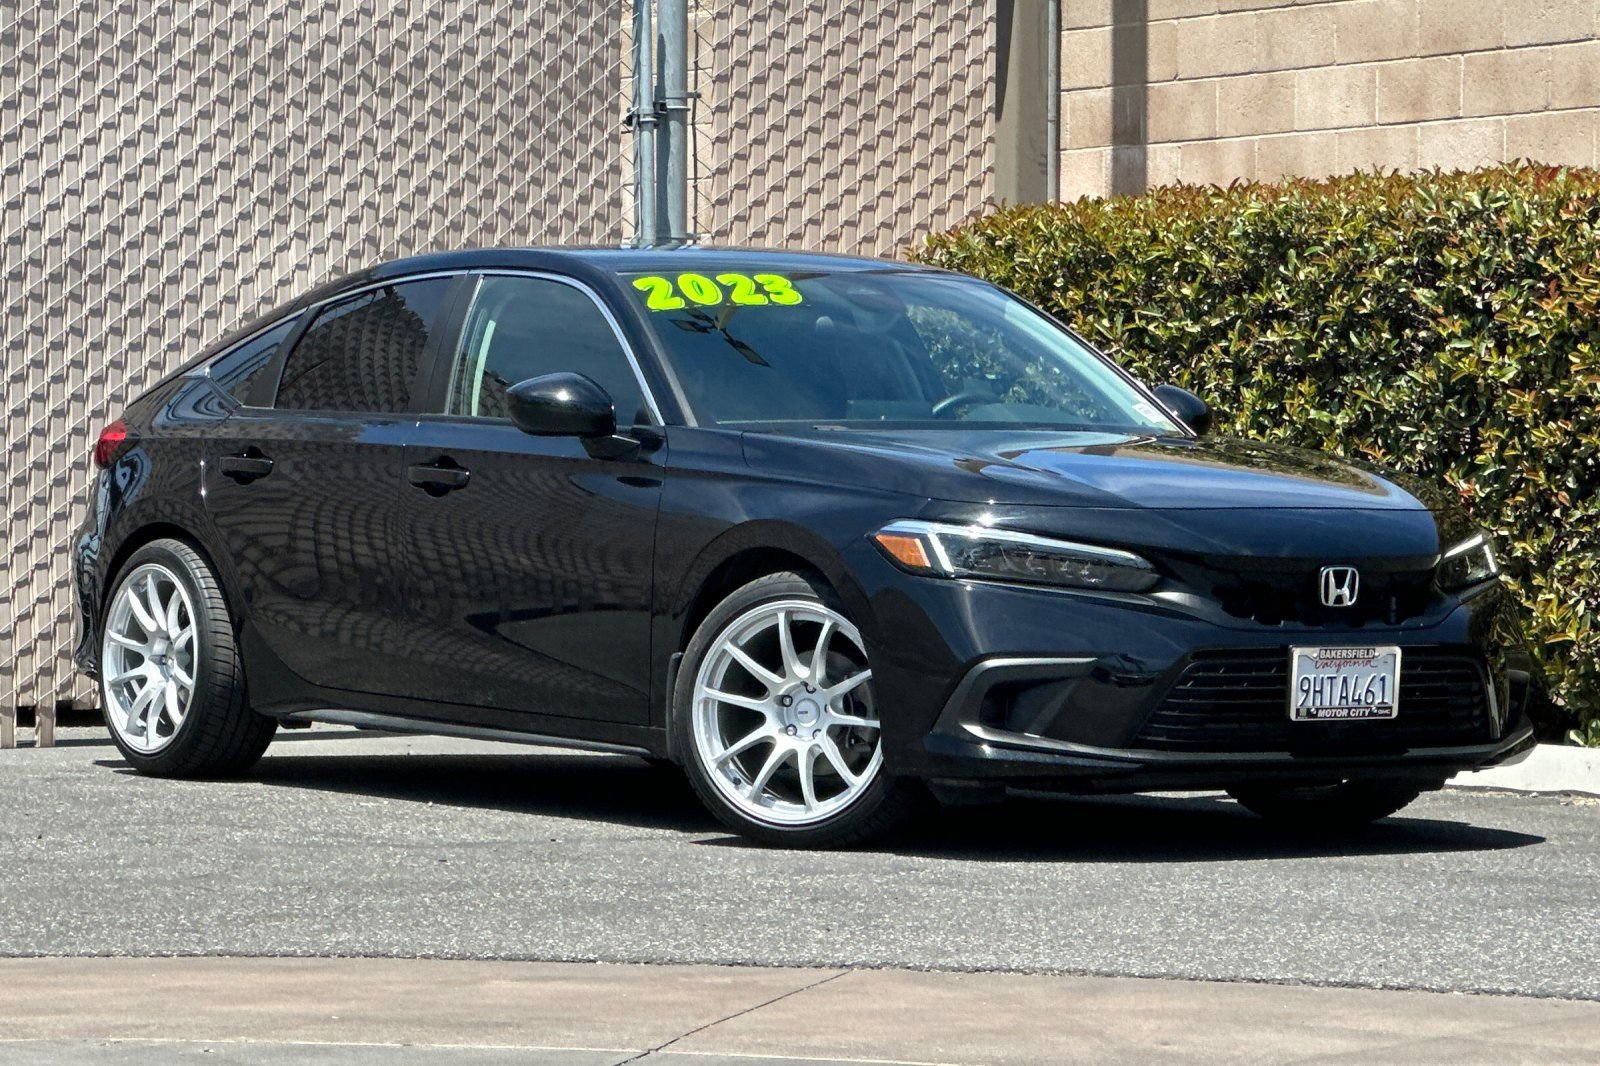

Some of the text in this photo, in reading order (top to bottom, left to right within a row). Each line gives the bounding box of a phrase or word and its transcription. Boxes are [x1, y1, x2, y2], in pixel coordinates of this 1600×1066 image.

[632, 273, 803, 311] 2023
[1320, 649, 1375, 659] BAKERSFIELD
[1314, 658, 1378, 673] California
[1299, 673, 1389, 707] 9HTA461
[1318, 708, 1349, 718] MOTOR
[1350, 708, 1371, 717] CITY
